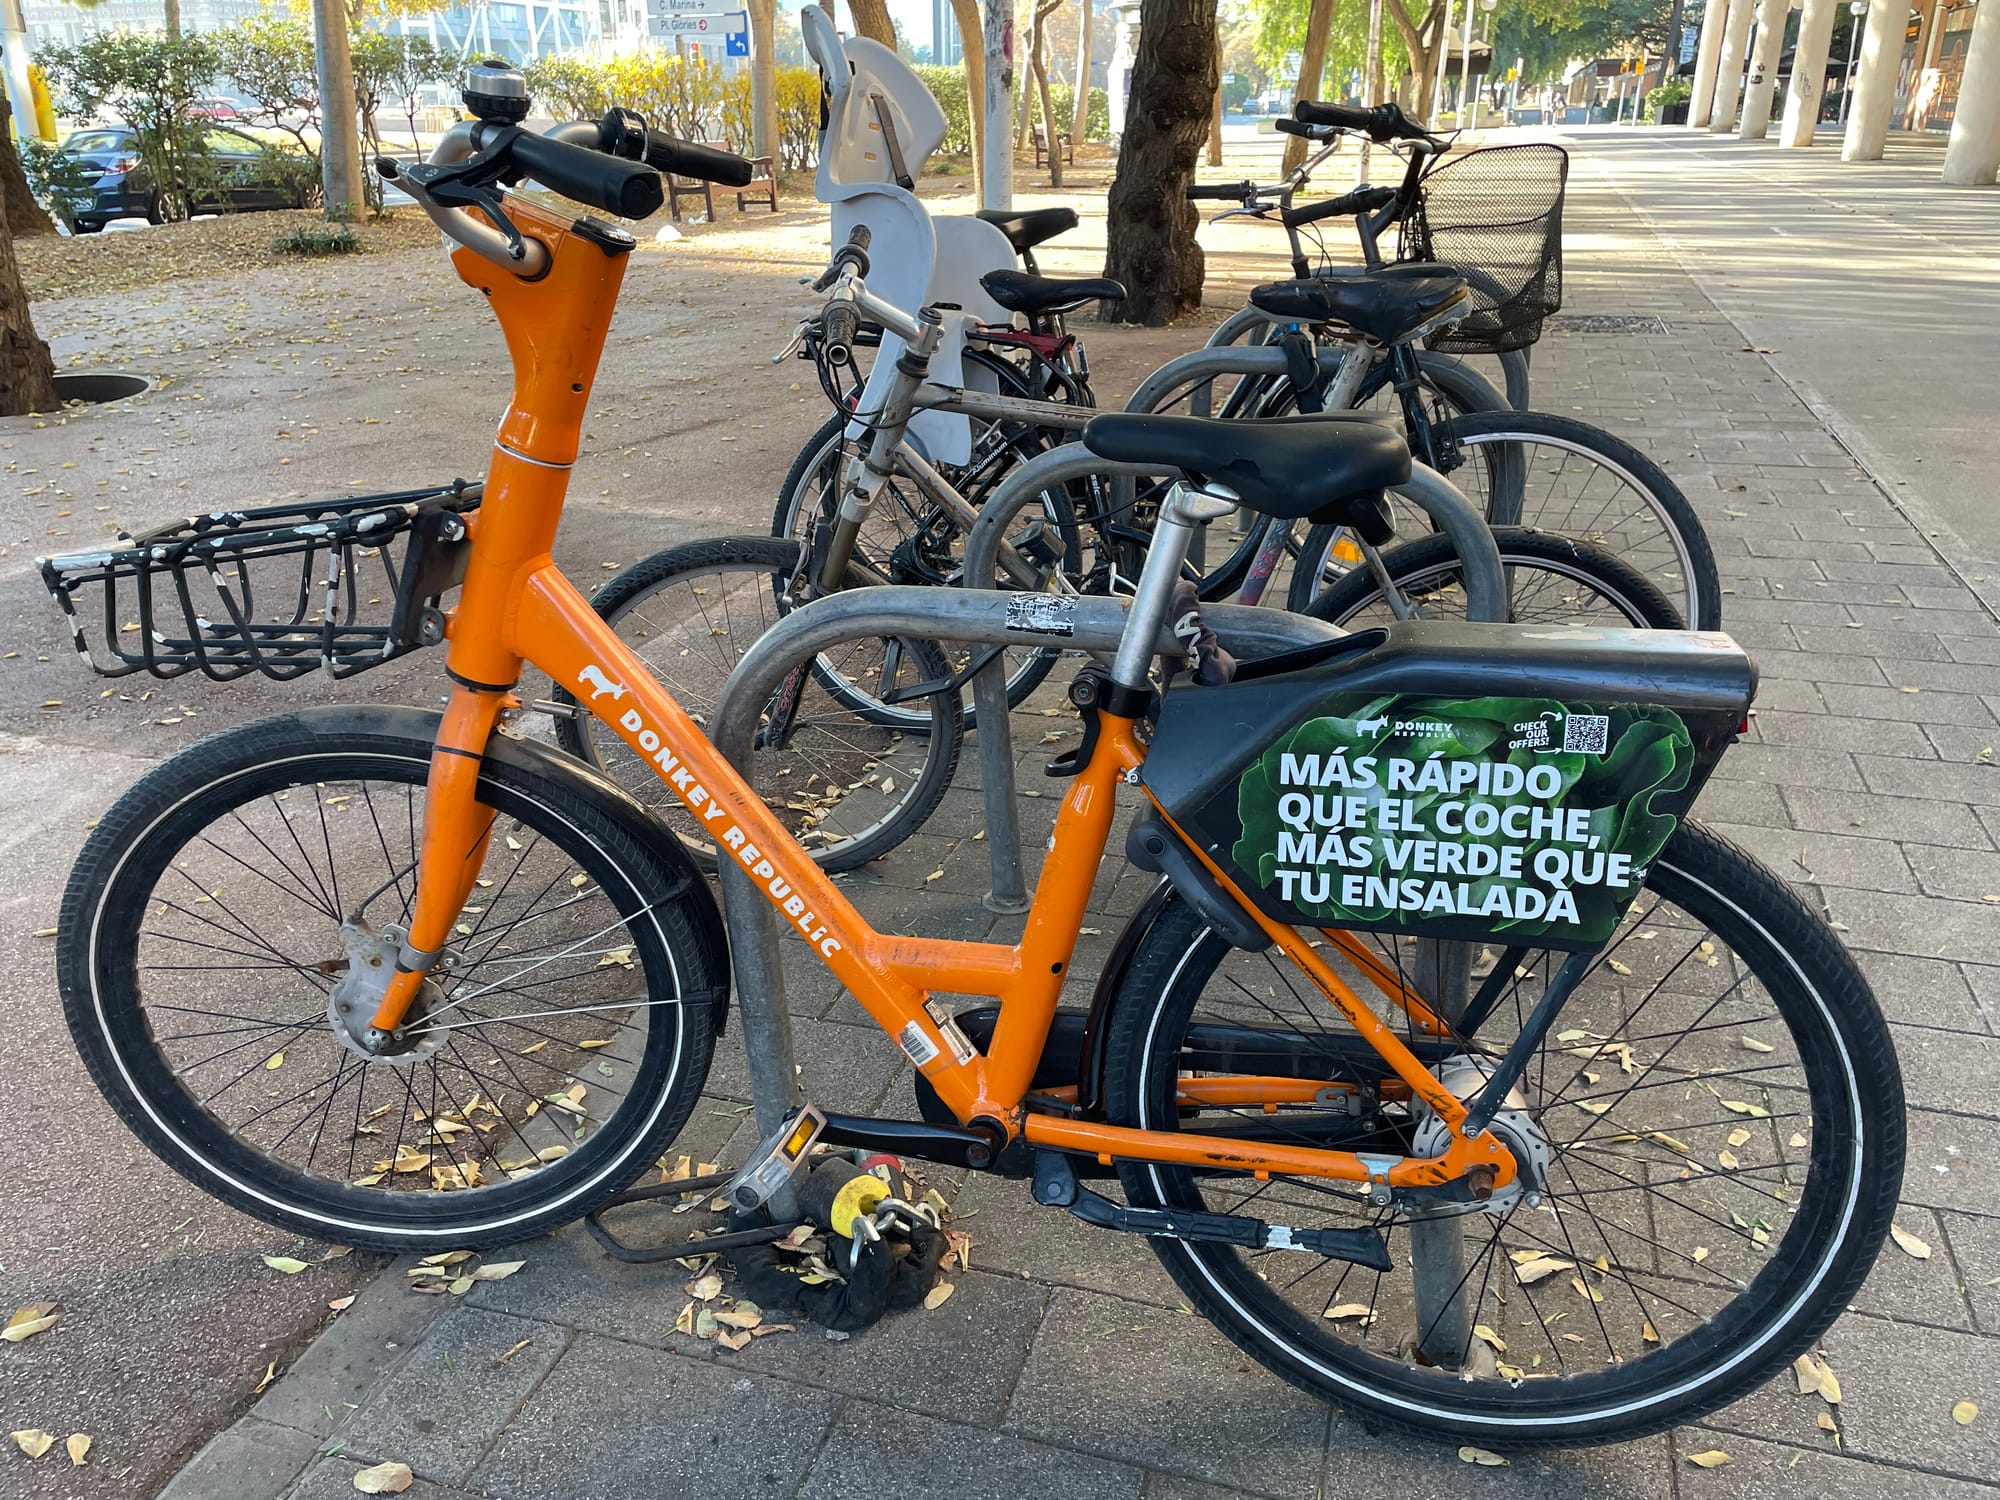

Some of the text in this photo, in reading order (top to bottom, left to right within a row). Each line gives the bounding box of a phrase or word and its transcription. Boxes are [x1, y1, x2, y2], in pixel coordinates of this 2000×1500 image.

[670, 0, 696, 9] Marina
[972, 441, 1008, 475] Aluminium
[1394, 721, 1453, 733] DONKEY
[1394, 731, 1453, 739] REPUBLIC
[1513, 720, 1548, 732] CHECK
[1525, 729, 1548, 740] OUR
[1508, 736, 1550, 750] OFFERS!
[1280, 746, 1562, 799] MÁS RÁPIDO
[1277, 792, 1602, 848] QUE EL COCHE,
[620, 707, 842, 959] DONKEY REPUBLIC
[1276, 825, 1633, 894] MÁS VERDE QUE
[1274, 869, 1581, 925] TU ENSALADA
